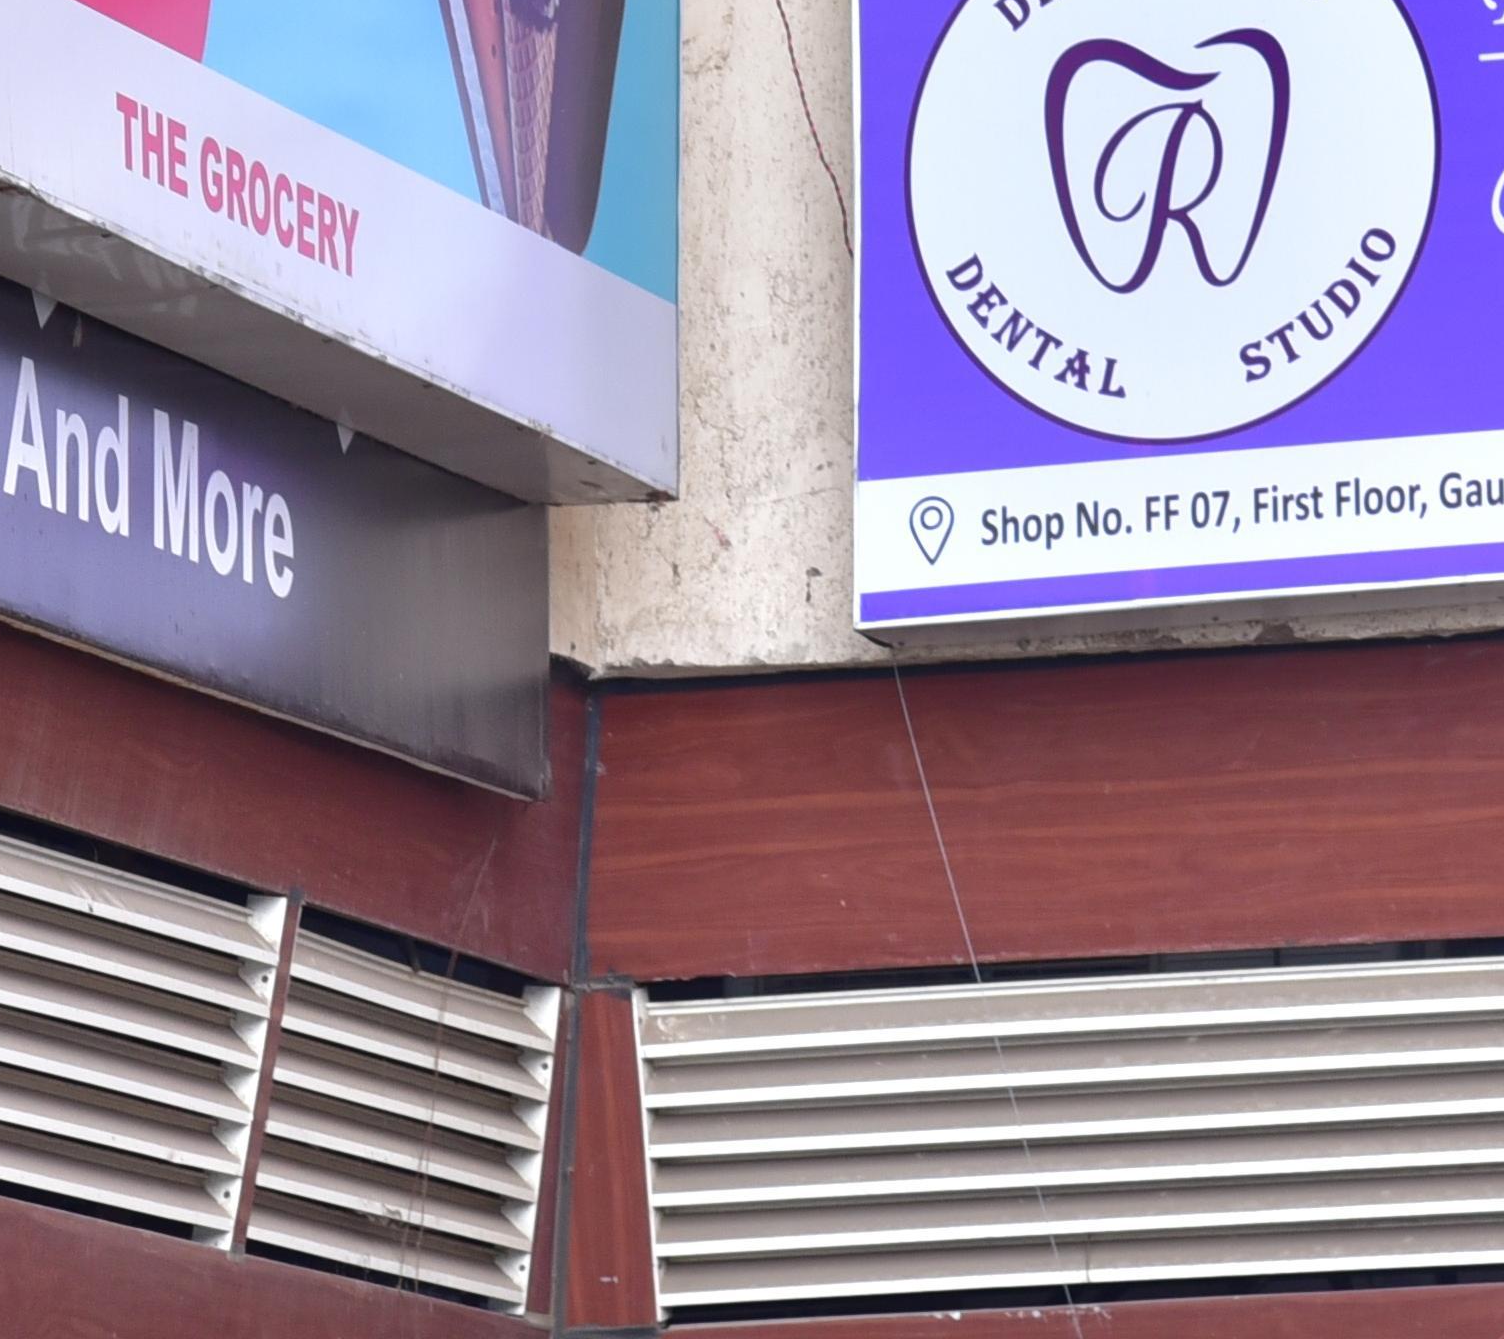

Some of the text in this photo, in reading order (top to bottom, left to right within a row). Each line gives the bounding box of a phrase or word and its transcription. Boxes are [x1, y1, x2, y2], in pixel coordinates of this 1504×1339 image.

[114, 91, 361, 277] THE GROCERY
[946, 224, 1398, 400] DENTAL STUDIO
[3, 356, 130, 539] And
[152, 408, 295, 599] More
[982, 506, 1064, 550] Shop
[1077, 501, 1132, 538] No.
[1146, 493, 1179, 532] FF
[1191, 490, 1240, 534] 07,
[1254, 485, 1323, 524] First
[1336, 477, 1427, 519] Floor,
